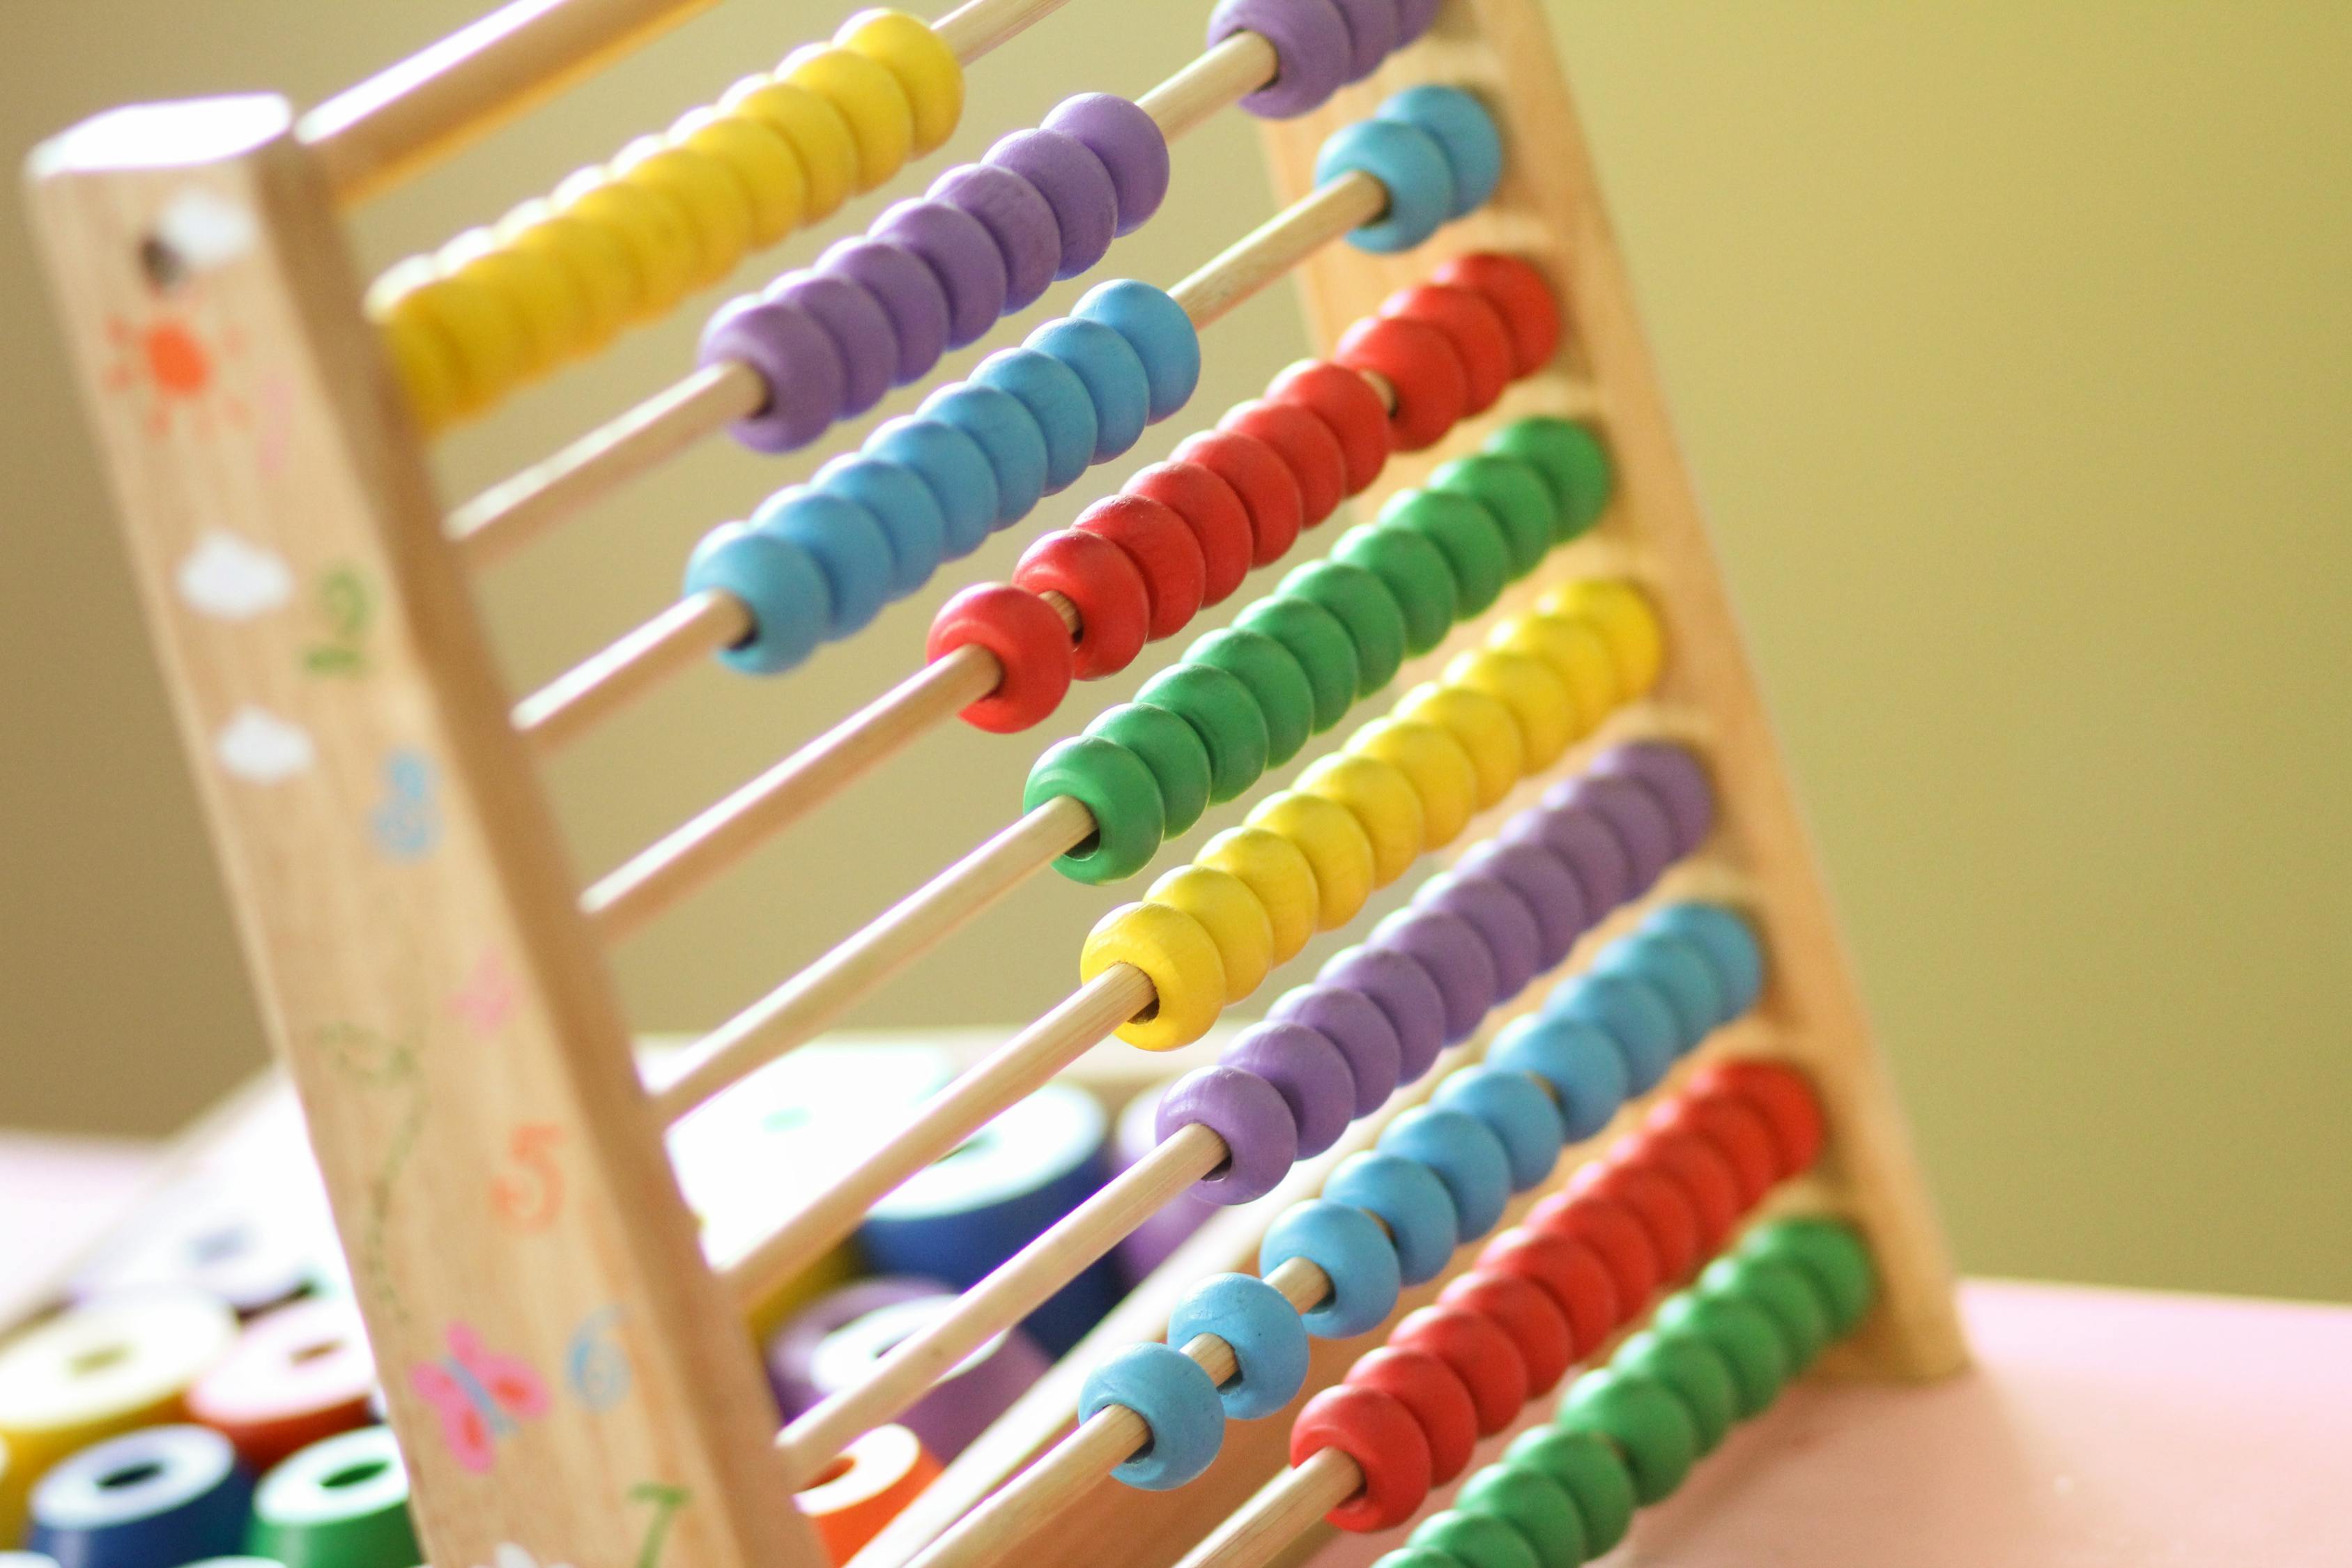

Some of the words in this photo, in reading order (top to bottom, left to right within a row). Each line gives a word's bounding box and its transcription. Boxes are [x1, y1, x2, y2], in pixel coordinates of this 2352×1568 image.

[302, 562, 375, 677] 2
[489, 1123, 566, 1233] 5
[564, 1305, 631, 1415] 6
[629, 1482, 691, 1568] 7
